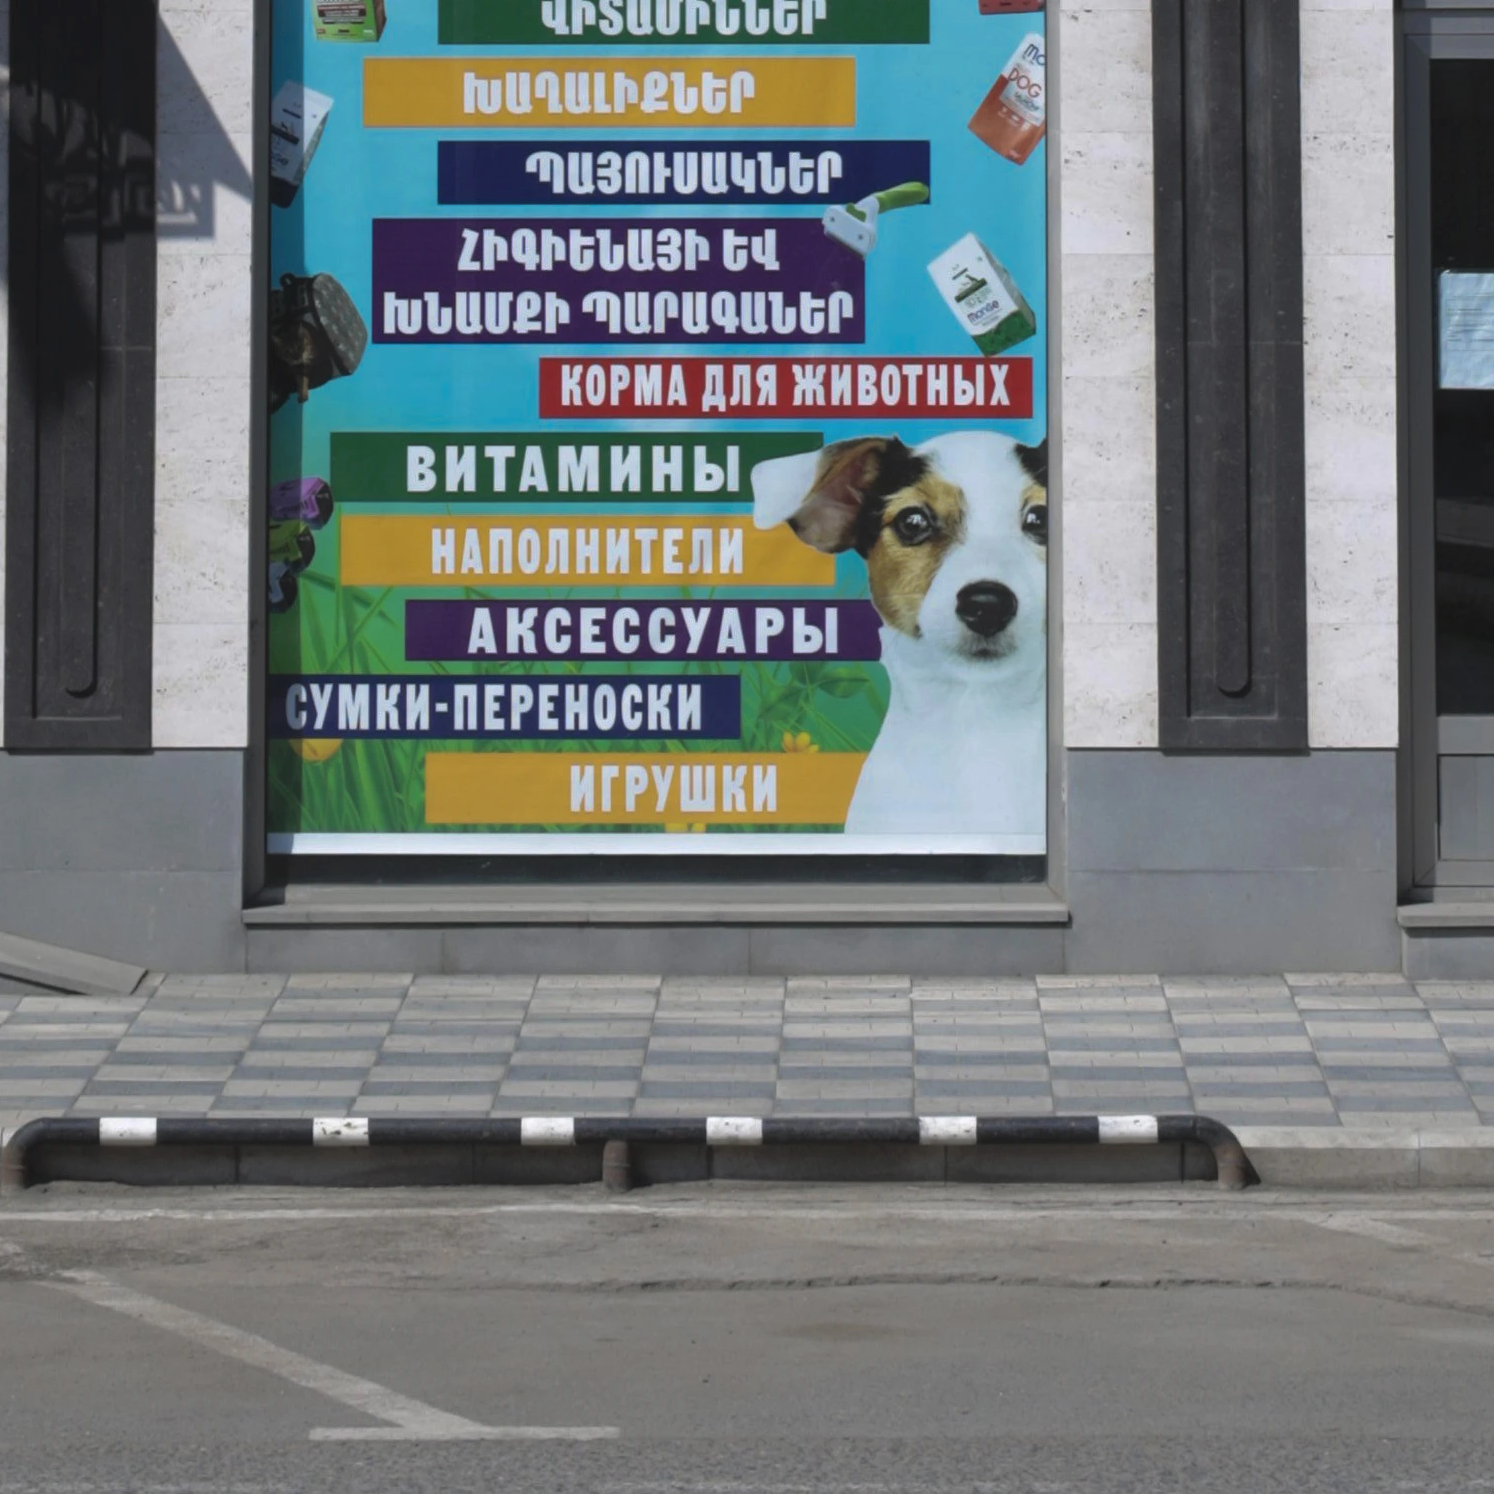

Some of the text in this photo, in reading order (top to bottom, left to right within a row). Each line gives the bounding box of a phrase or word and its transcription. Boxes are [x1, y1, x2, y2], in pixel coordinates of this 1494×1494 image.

[462, 71, 756, 115] ԽԱՂԱԼԻՔՆԵՐ
[1008, 68, 1042, 98] DOG
[525, 151, 843, 196] ՊԱՅՈՒՍԱԿՆԵՐ
[458, 228, 781, 272] ՀԻԳԻԵՆԱՅԻ ԵՎ
[383, 291, 855, 336] ԽՆԱՄՔԻ ՊԱՐԱԳԱՆԵՐ
[560, 363, 1011, 413] КОРМА ДЛЯ ЖИВОТНЫХ
[406, 445, 741, 494] ВИТАМИНЫ
[431, 527, 745, 576] НАПОЛНИТЕЛИ
[466, 606, 840, 655] АКСЕССУАРЫ
[285, 682, 703, 732] СУМКИ-ПЕРЕНОСКИ
[569, 764, 779, 813] ИГРУШКИ
